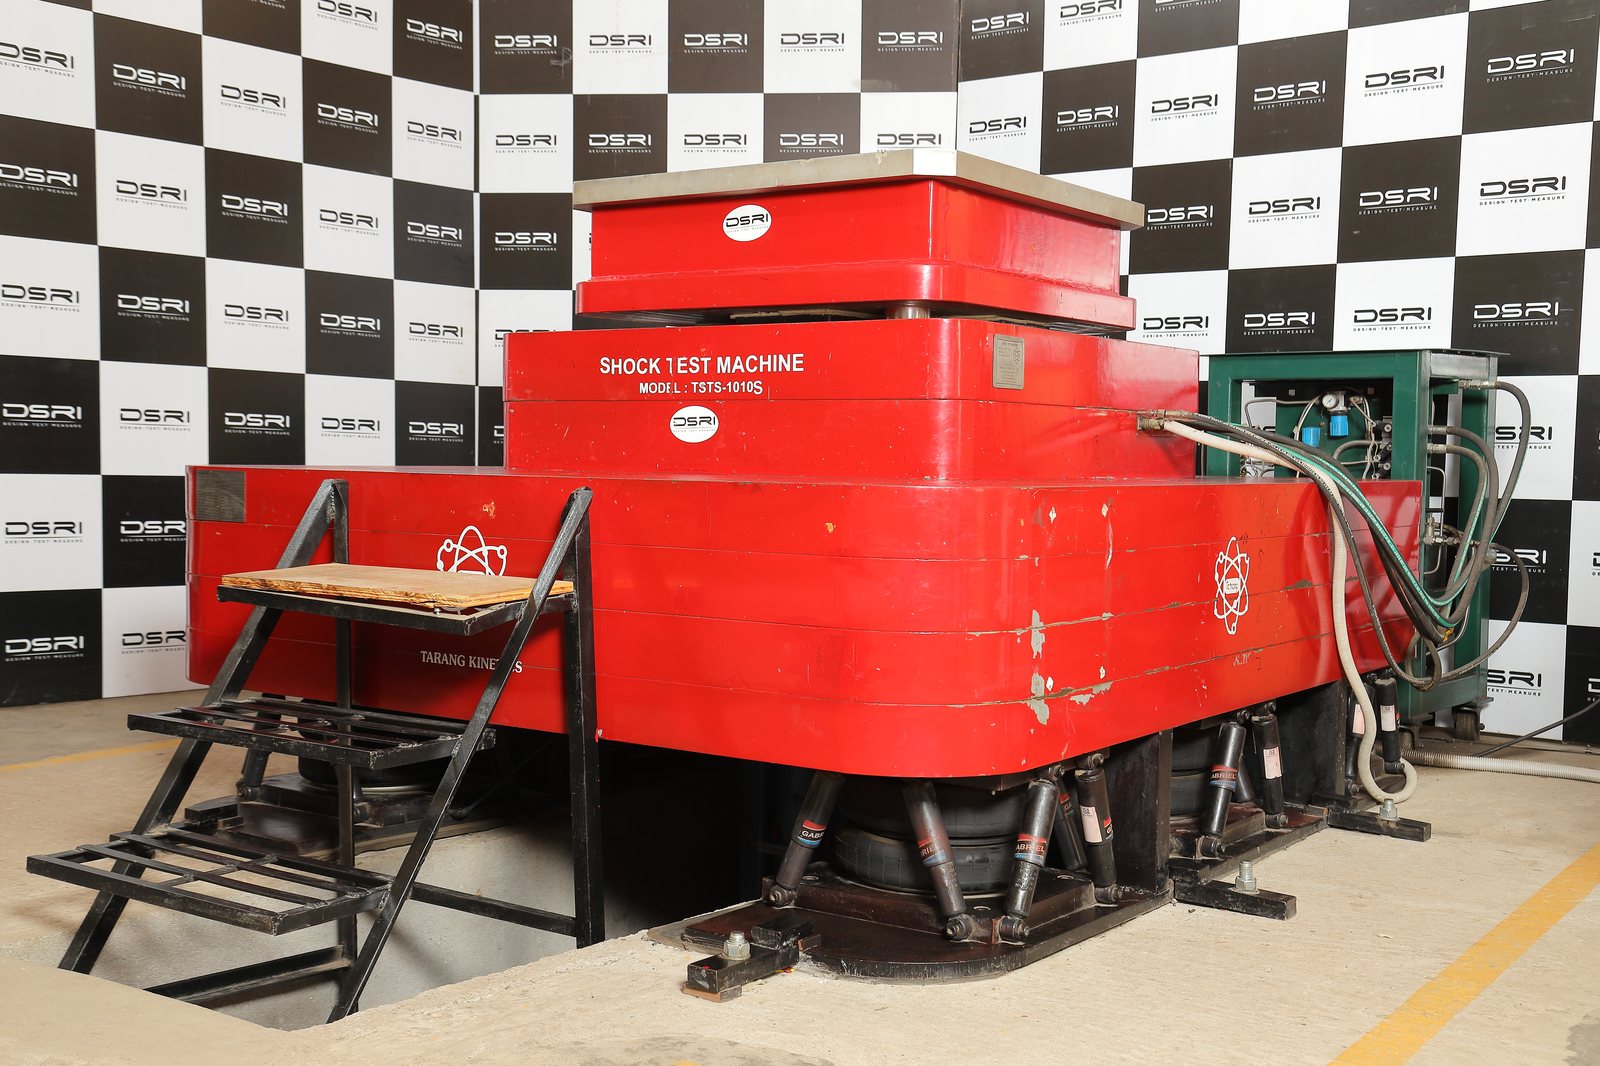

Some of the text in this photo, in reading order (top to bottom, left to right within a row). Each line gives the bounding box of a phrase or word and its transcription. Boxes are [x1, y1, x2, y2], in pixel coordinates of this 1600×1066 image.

[318, 0, 377, 22] DSRI
[1060, 0, 1122, 18] DSRI
[972, 12, 1030, 32] DSRI
[407, 18, 462, 44] DSRI
[781, 33, 844, 45] DSRI
[878, 32, 944, 44] DSRI
[495, 35, 557, 48] DSRI
[590, 35, 651, 46] DSRI
[684, 34, 748, 46] DSRI
[0, 42, 74, 69] DSRI
[1488, 48, 1575, 74] DSRI
[113, 64, 186, 90] DSRI
[1365, 65, 1444, 88] DSRI
[221, 84, 286, 108] DSRI
[1254, 80, 1326, 102] DSRI
[1152, 94, 1218, 114] DSRI
[318, 103, 378, 126] DSRI
[1057, 105, 1118, 124] DSRI
[408, 121, 462, 141] DSRI
[969, 116, 1026, 134] DSRI
[496, 135, 556, 146] DSRI
[588, 134, 652, 146] DSRI
[684, 134, 747, 145] DSRI
[780, 134, 843, 145] DSRI
[877, 134, 941, 145] DSRI
[116, 180, 186, 202] DSRI
[1480, 176, 1566, 197] DSRI
[1360, 186, 1438, 206] DSRI
[222, 194, 288, 216] DSRI
[1148, 205, 1214, 222] DSRI
[1248, 196, 1320, 215] DSRI
[320, 209, 378, 228] DSRI
[726, 213, 768, 227] DSRI
[407, 222, 462, 240] DSRI
[495, 232, 556, 244] DSRI
[2, 284, 79, 303] DSRI
[118, 294, 190, 313] DSRI
[1474, 302, 1559, 319] DSRI
[224, 304, 288, 322] DSRI
[320, 313, 380, 330] DSRI
[1244, 312, 1316, 328] DSRI
[1354, 307, 1432, 323] DSRI
[409, 322, 463, 338] DSRI
[1143, 316, 1209, 330] DSRI
[600, 354, 804, 375] SHOCK TEST MACHINE
[639, 382, 680, 394] MODEL
[691, 380, 763, 394] TSTS-1010S
[2, 403, 82, 420] DSRI
[120, 408, 190, 423] DSRI
[225, 412, 290, 428] DSRI
[322, 417, 380, 431] DSRI
[409, 422, 463, 435] DSRI
[673, 416, 715, 426] DSRI
[5, 522, 82, 535] DSRI
[120, 520, 185, 534] DSR
[5, 636, 84, 653] DSRI
[122, 630, 185, 646] DSR
[420, 650, 522, 673] TARANG KINES
[1487, 669, 1542, 687] SRI
